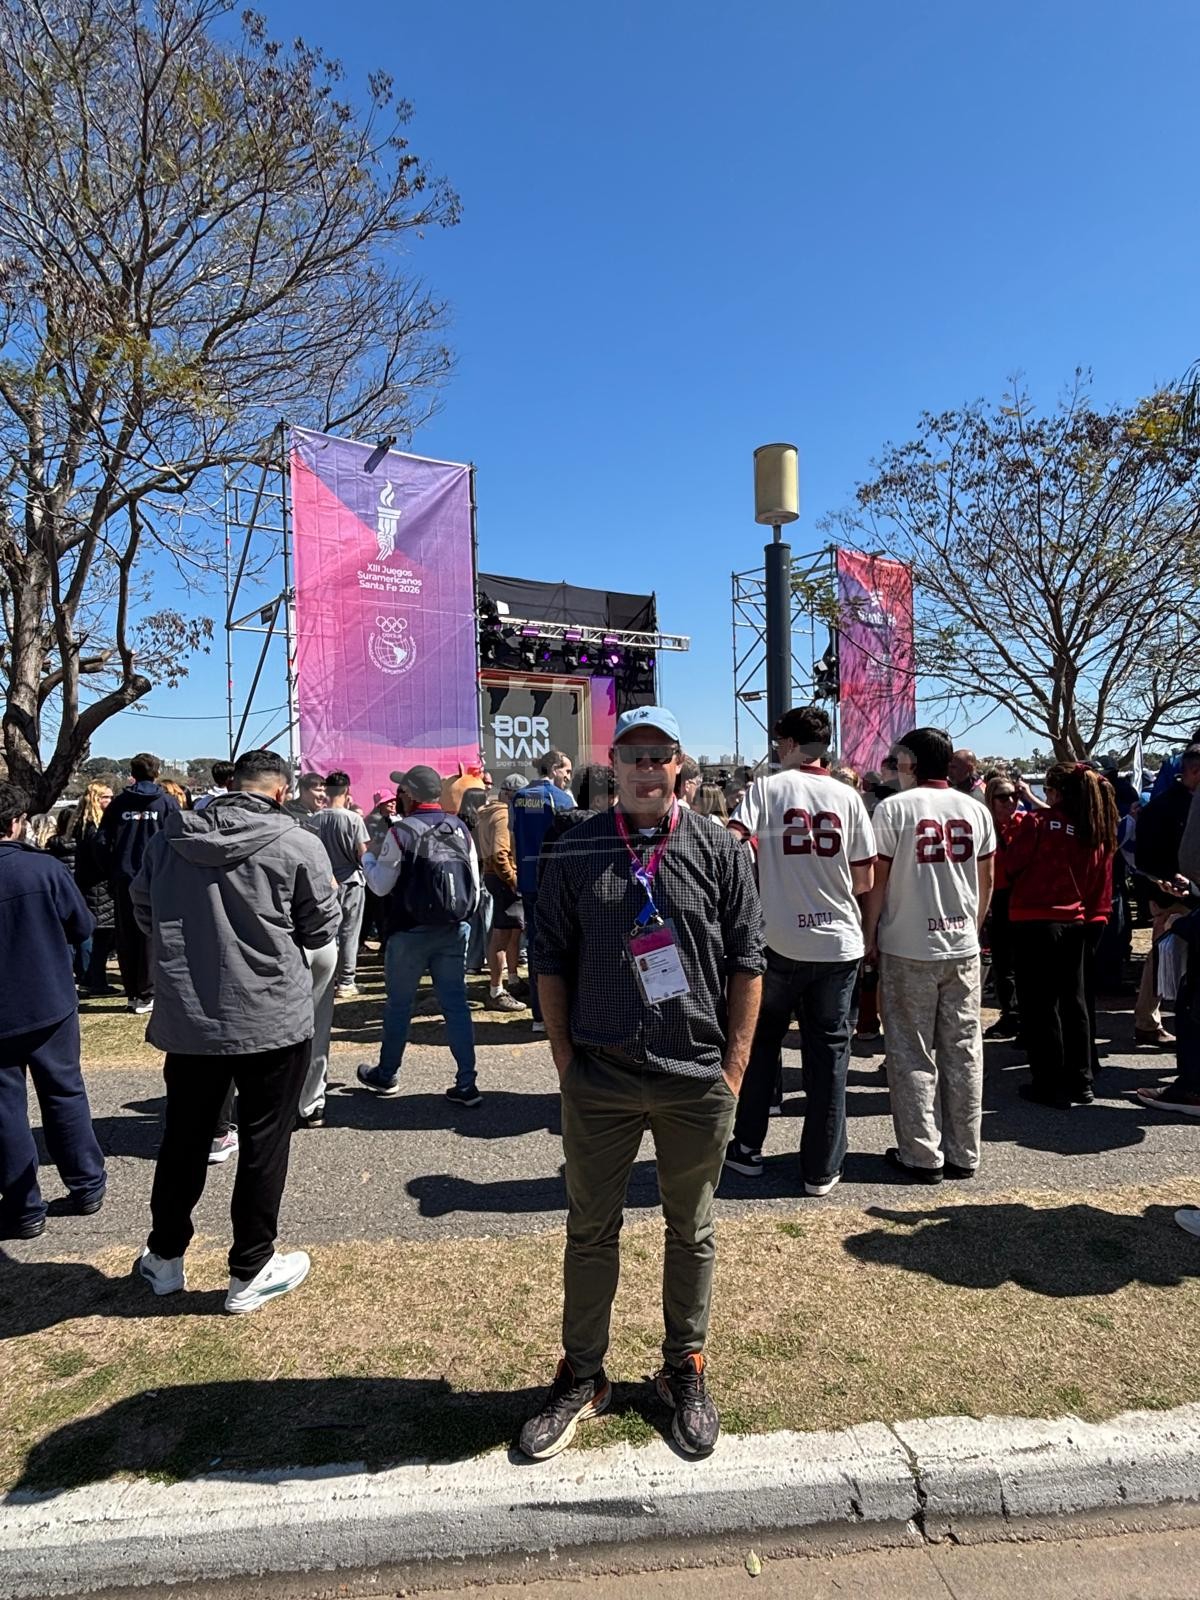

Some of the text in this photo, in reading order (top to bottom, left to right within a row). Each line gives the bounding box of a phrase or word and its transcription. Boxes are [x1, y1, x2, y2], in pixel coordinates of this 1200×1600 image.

[356, 570, 423, 586] Suramericanos
[366, 562, 413, 578] XIII Juegos
[358, 579, 421, 595] Santa Fe 2026
[490, 715, 550, 738] BOR
[495, 737, 550, 760] NAN
[783, 807, 842, 858] 26
[915, 818, 974, 864] 26
[797, 911, 833, 929] BATU
[927, 915, 966, 932] DAVID
